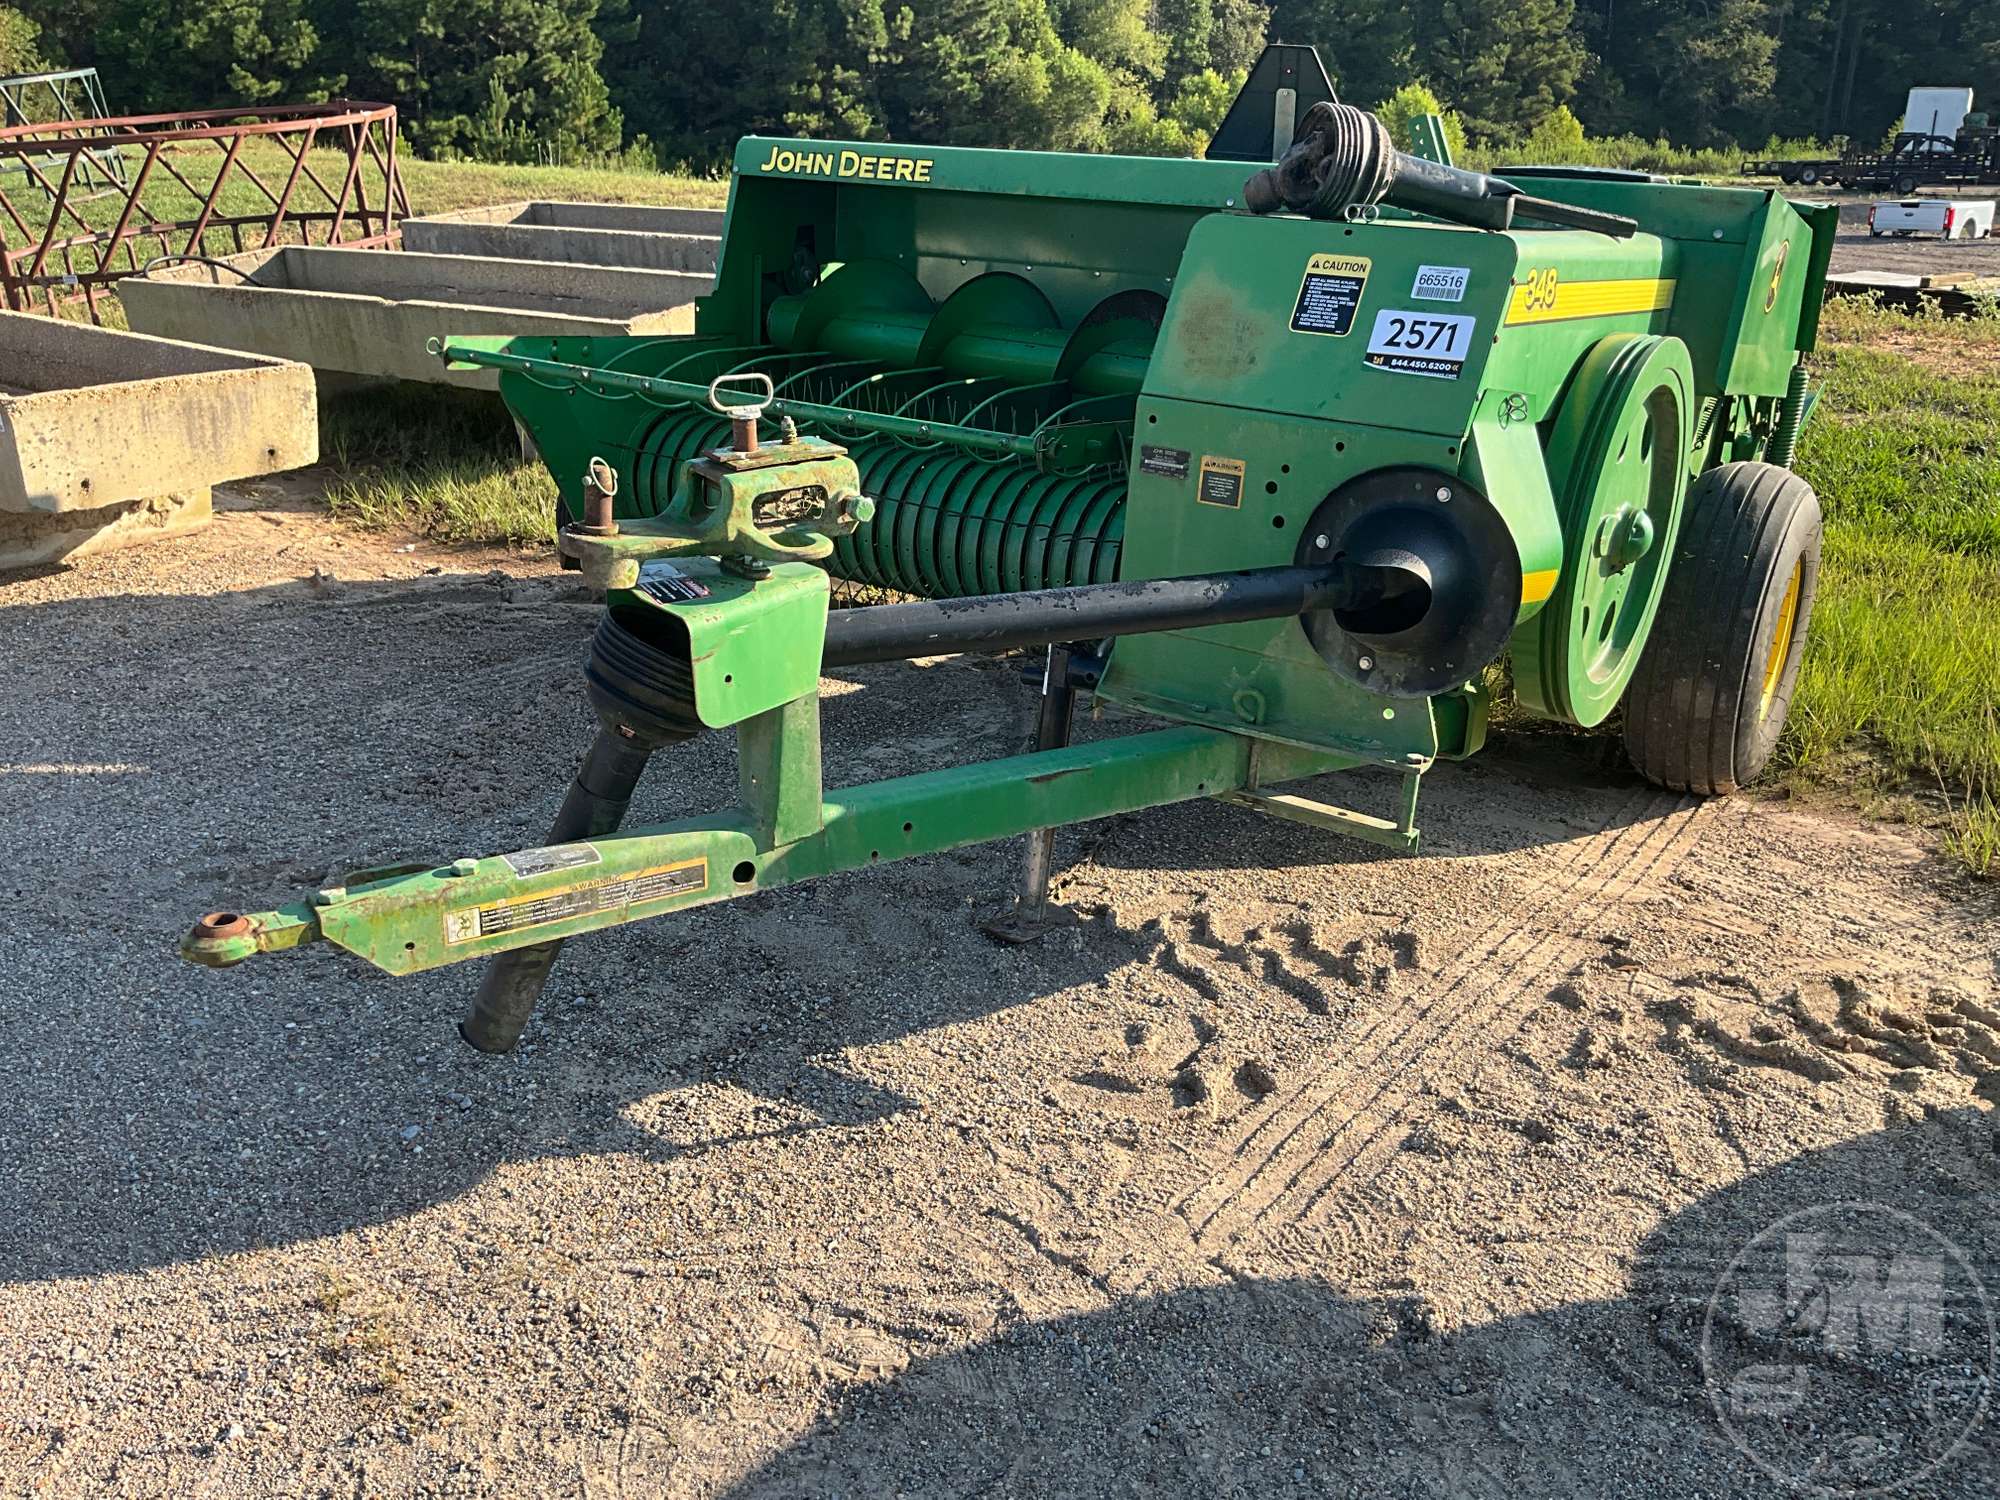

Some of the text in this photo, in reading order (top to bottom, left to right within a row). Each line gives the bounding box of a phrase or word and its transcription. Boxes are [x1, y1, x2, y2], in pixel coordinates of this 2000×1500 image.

[760, 146, 934, 182] JOHN DEERE
[1322, 260, 1367, 273] CAUTION
[1418, 273, 1463, 288] 665516
[1524, 266, 1559, 312] 348
[1383, 317, 1459, 352] 2571
[1390, 358, 1451, 372] 844.450.6200
[578, 874, 622, 891] WARNING
